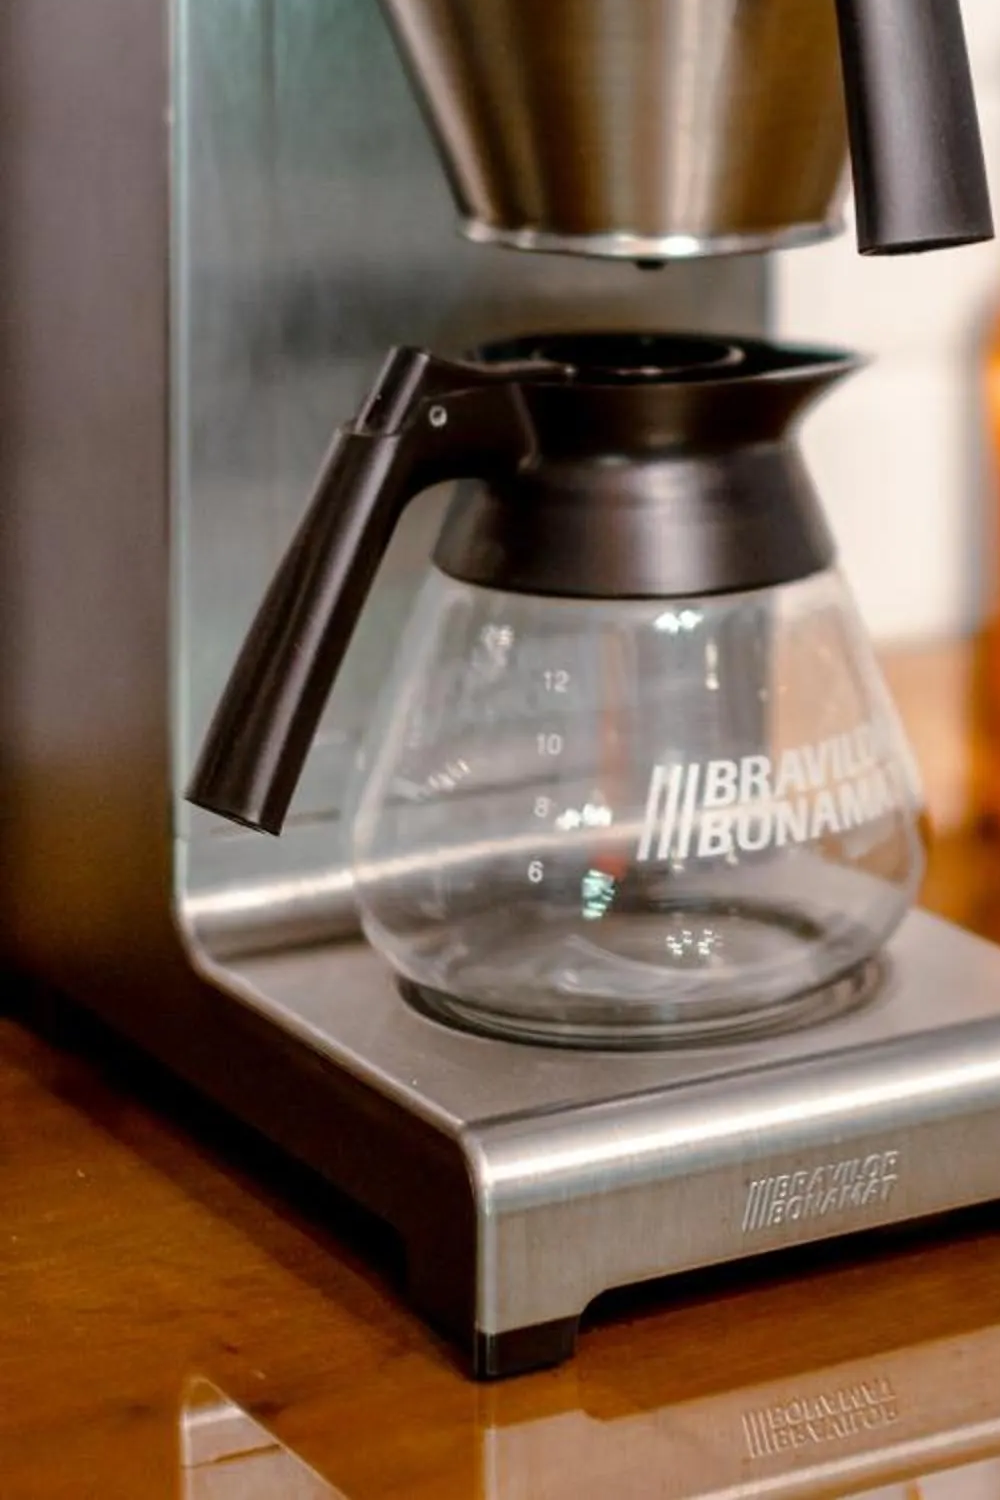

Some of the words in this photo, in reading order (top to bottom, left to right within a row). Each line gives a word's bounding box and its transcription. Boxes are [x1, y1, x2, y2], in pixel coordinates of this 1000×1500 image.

[544, 669, 570, 693] 12
[536, 732, 562, 756] 10
[533, 797, 550, 818] 8
[527, 861, 544, 883] 6
